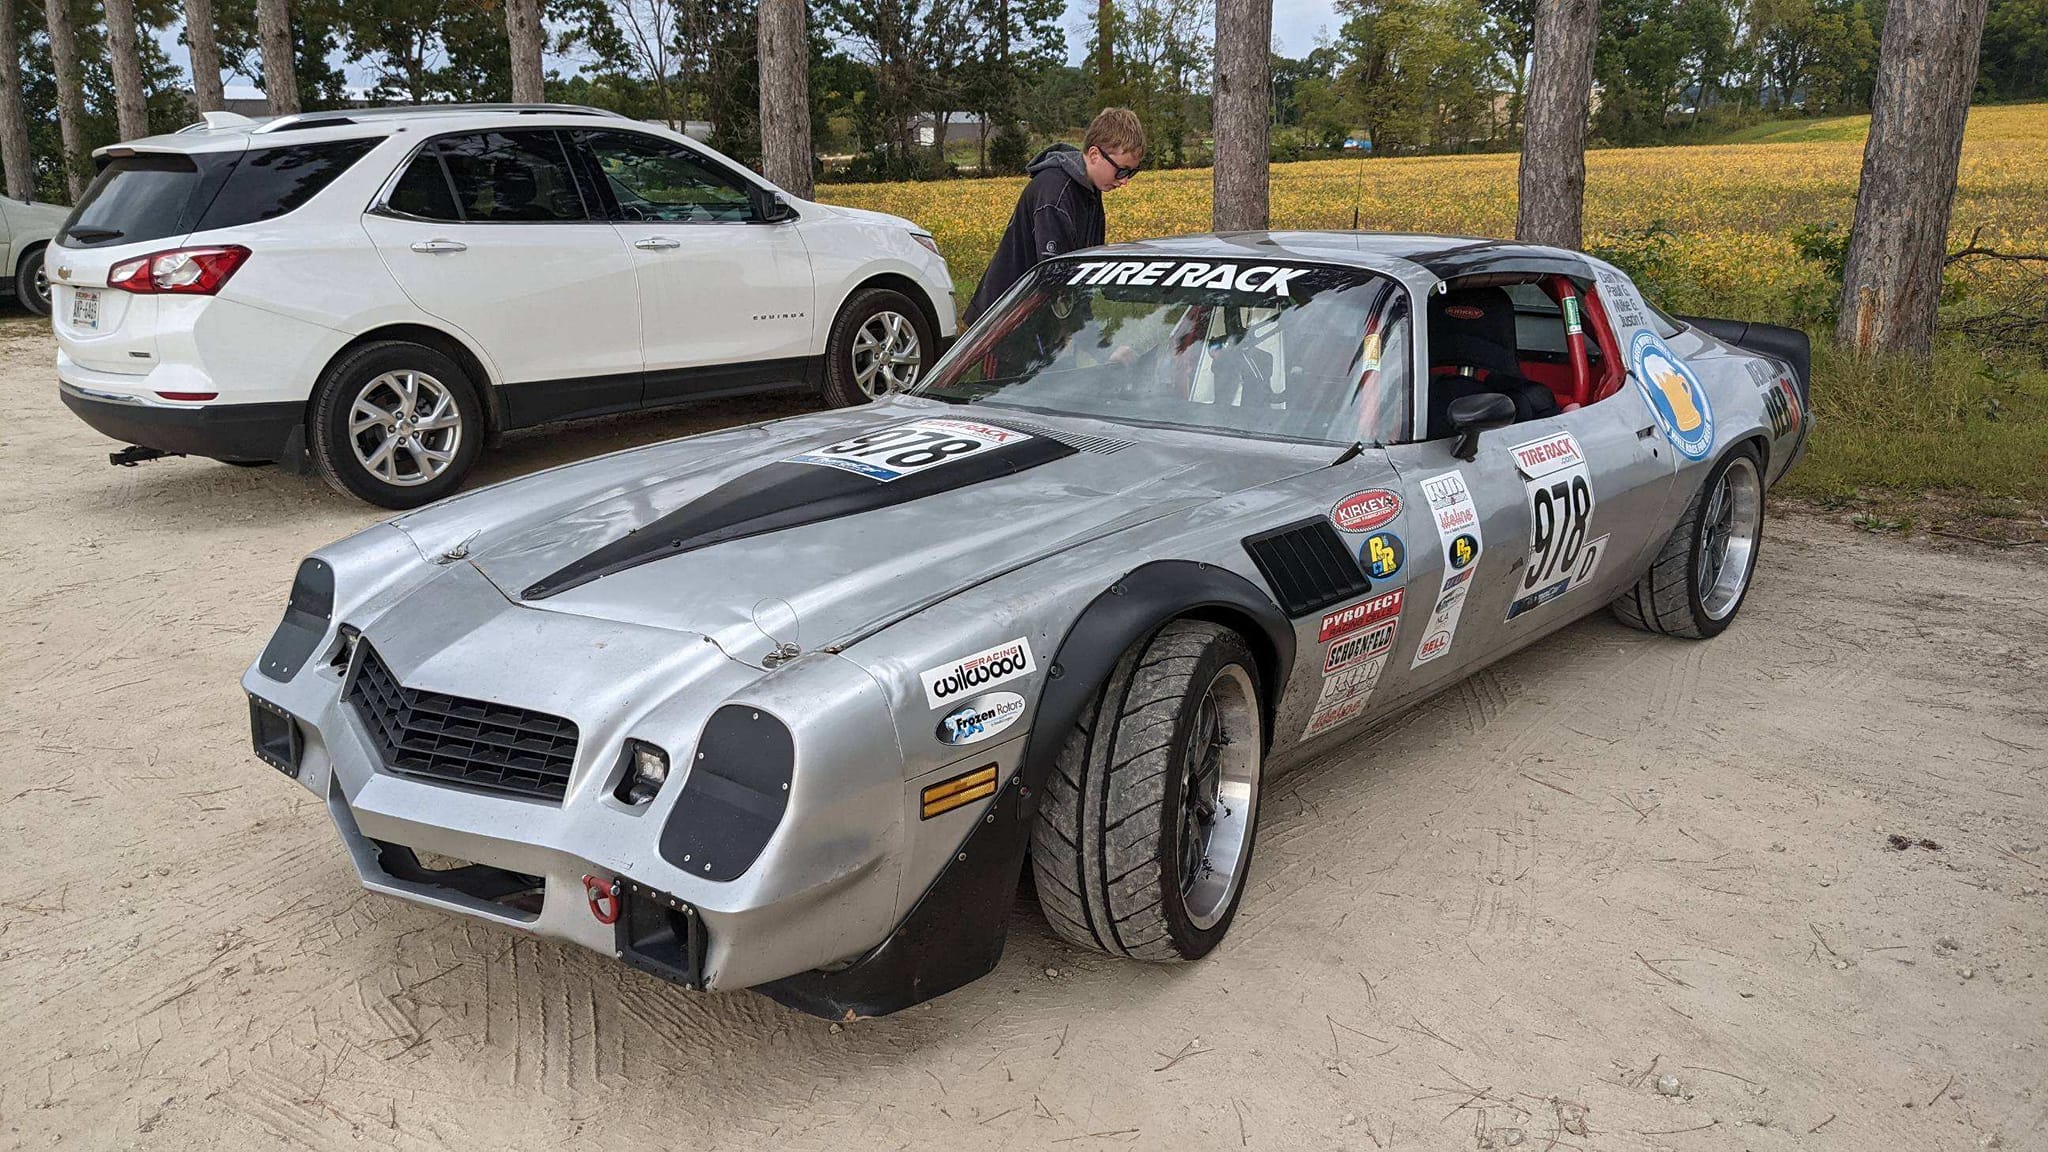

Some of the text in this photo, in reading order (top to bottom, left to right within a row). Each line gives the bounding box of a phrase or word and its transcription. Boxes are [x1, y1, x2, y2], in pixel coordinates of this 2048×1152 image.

[1605, 285, 1623, 297] Paul
[1613, 299, 1632, 312] Mike
[822, 429, 982, 468] 978
[1337, 496, 1385, 521] KIRKEY
[1524, 475, 1591, 589] 978
[1576, 545, 1597, 583] D
[1321, 591, 1403, 632] PYROTECT
[1329, 617, 1363, 637] RACING
[1365, 608, 1393, 625] CELLS
[978, 646, 1019, 665] RACING
[1328, 626, 1393, 668] SCHOENFELD
[1421, 635, 1446, 653] BELL
[933, 644, 1026, 698] wilwood
[957, 709, 996, 730] Frozen
[997, 699, 1023, 715] Rotors
